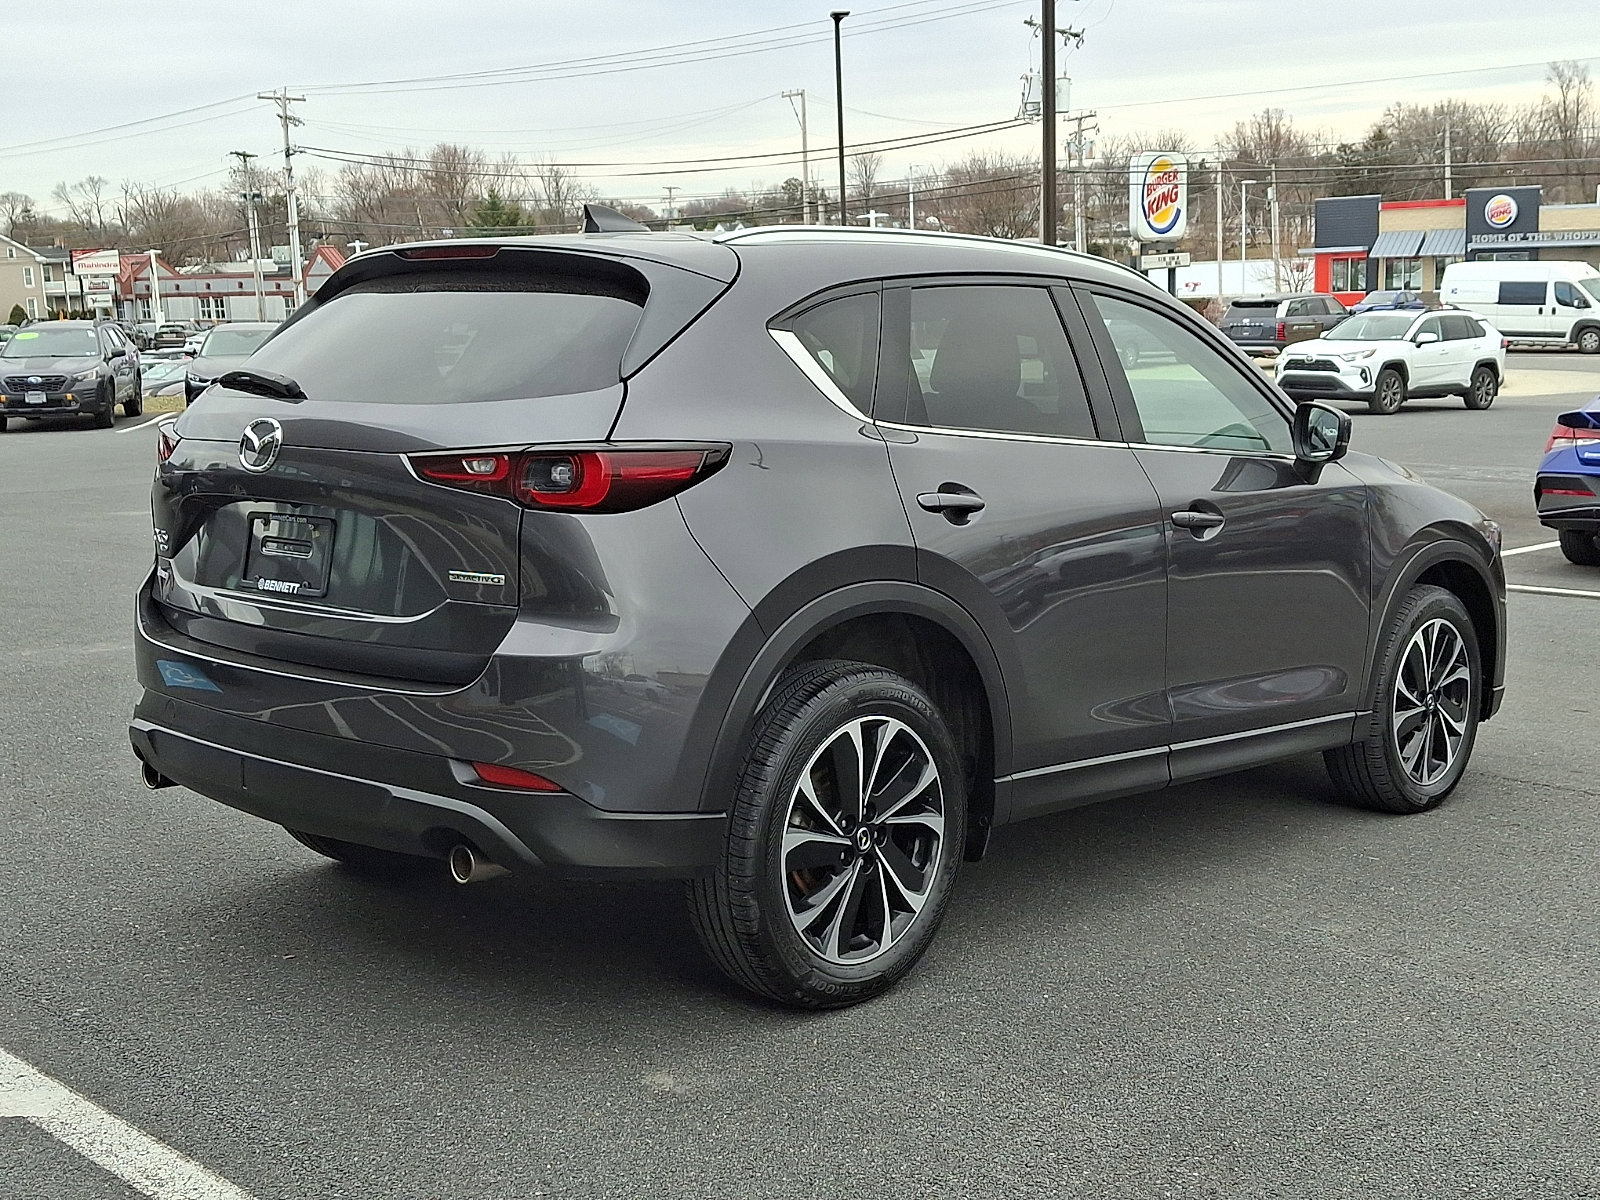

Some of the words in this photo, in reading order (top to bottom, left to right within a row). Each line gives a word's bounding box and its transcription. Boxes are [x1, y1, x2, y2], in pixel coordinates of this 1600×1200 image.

[1146, 169, 1179, 197] BURGER
[1147, 184, 1179, 219] KING
[1489, 207, 1512, 219] KING
[1471, 234, 1506, 243] HOME
[1508, 233, 1524, 242] OF
[1526, 232, 1551, 241] THE
[263, 580, 300, 594] BENNETT
